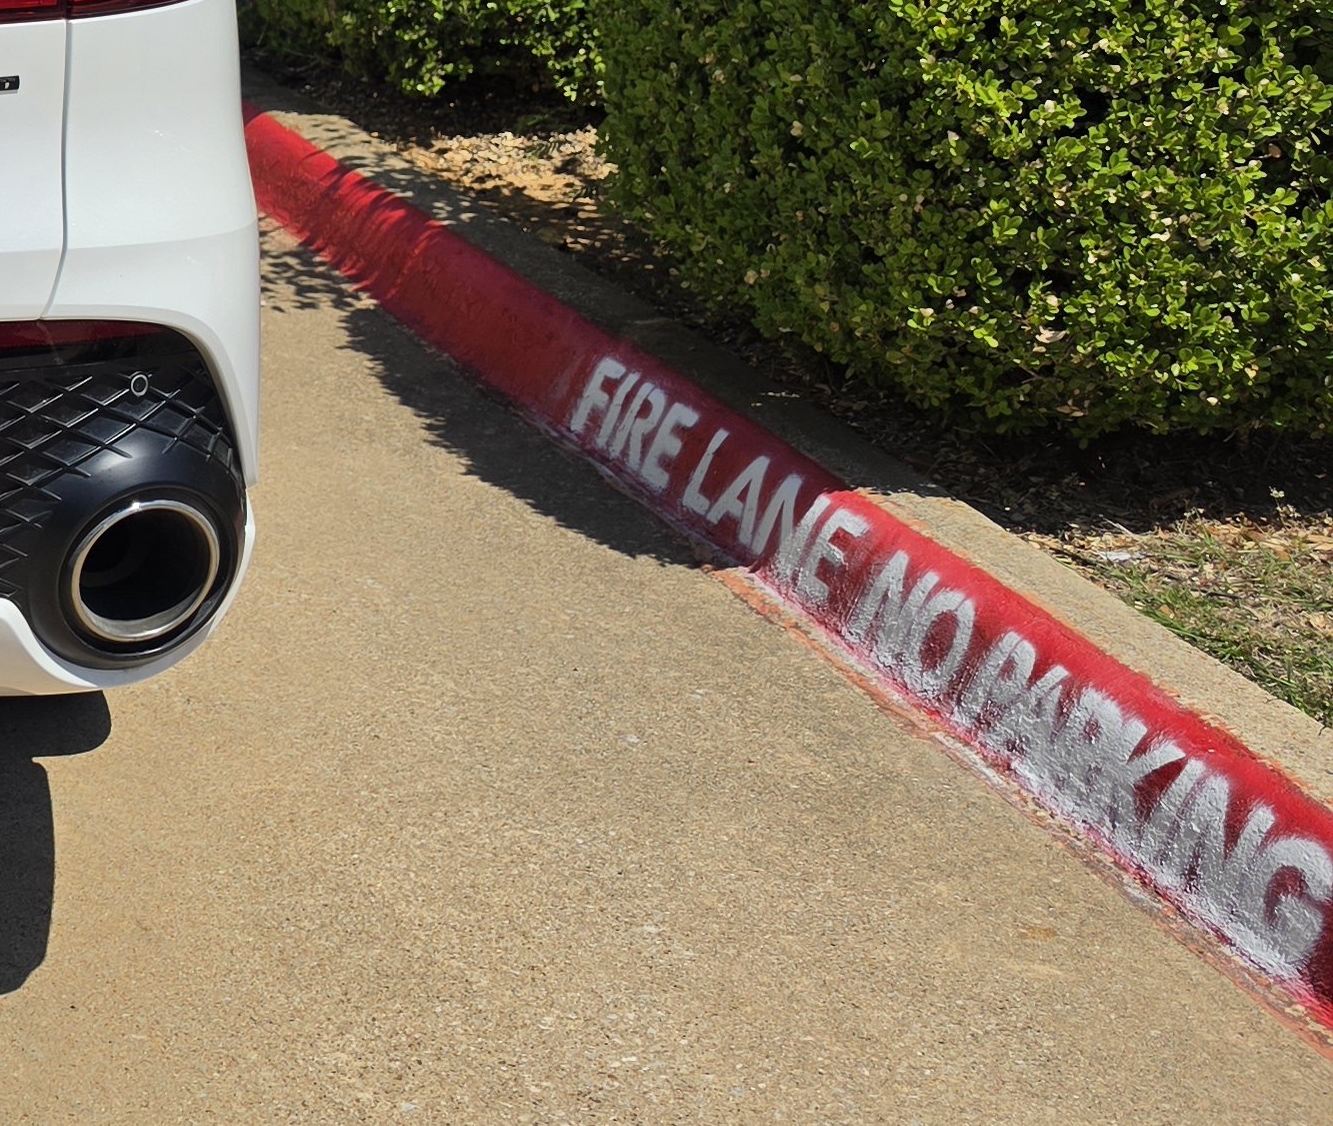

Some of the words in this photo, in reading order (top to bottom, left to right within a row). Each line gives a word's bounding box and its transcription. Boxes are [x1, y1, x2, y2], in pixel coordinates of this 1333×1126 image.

[569, 356, 699, 496] FIRE
[680, 426, 871, 605] LANE
[846, 548, 977, 703] NO
[949, 629, 1333, 982] PARKING
